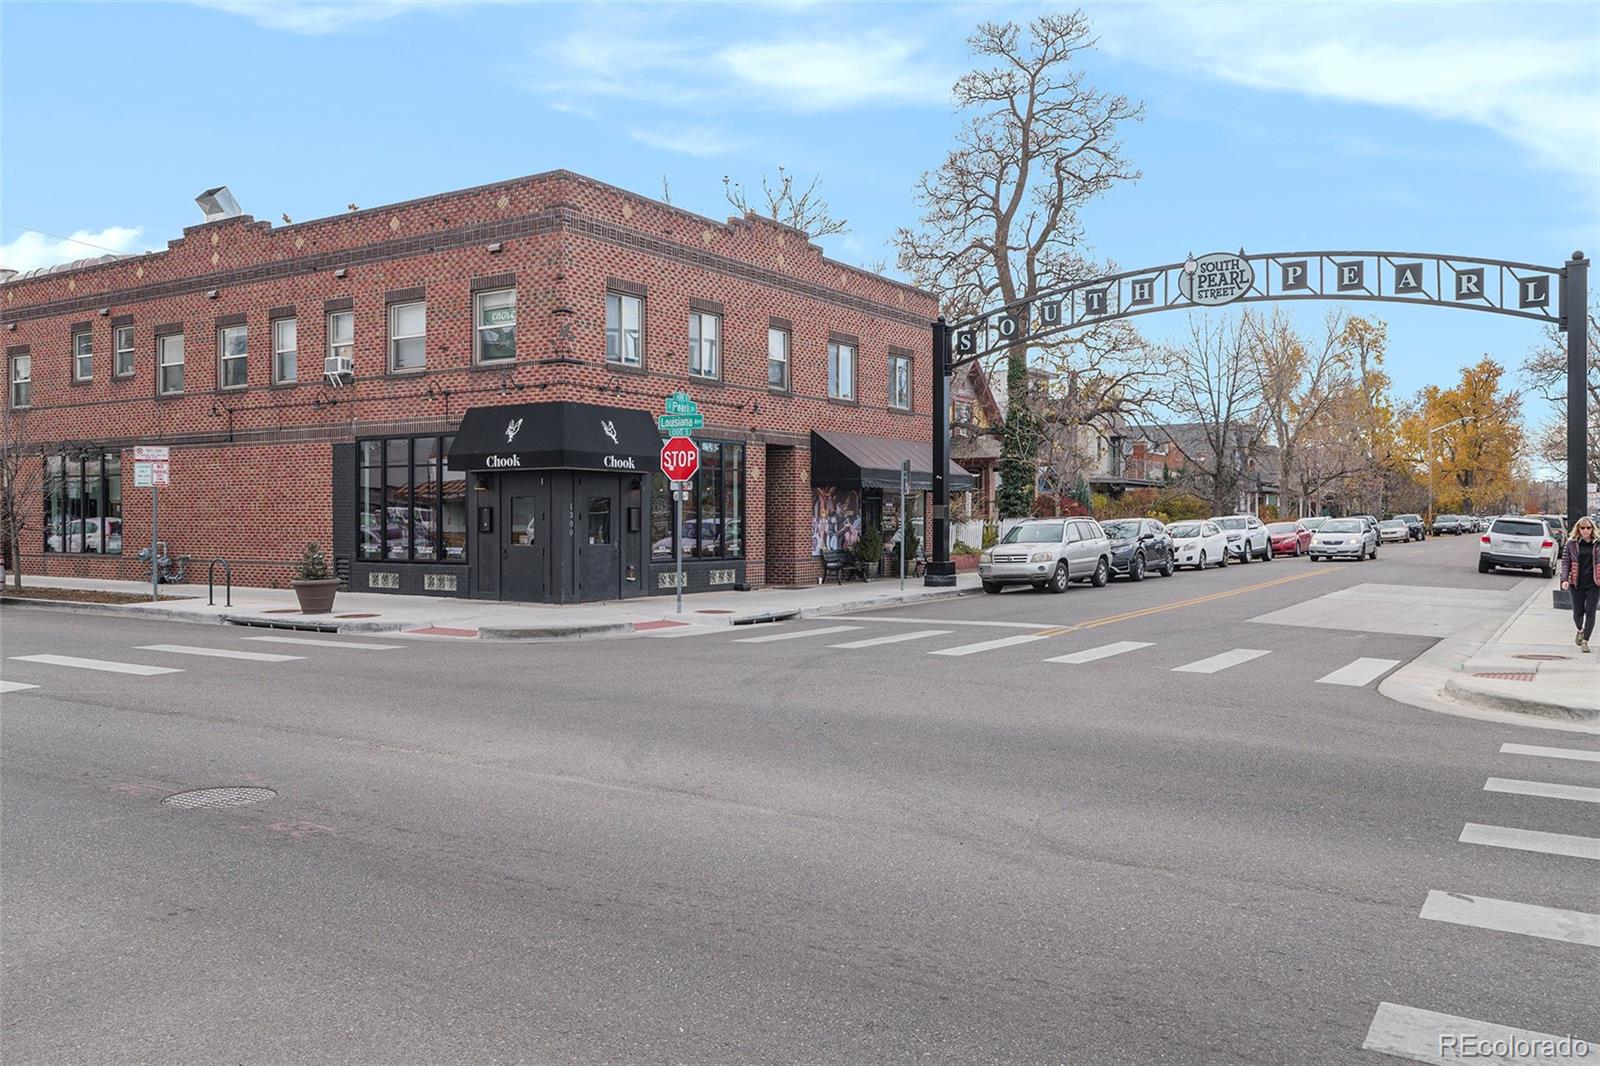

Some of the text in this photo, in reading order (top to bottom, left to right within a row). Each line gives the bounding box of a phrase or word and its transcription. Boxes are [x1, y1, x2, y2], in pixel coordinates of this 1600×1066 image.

[1200, 259, 1240, 273] SOUTH
[1197, 269, 1249, 290] PEARL
[1197, 287, 1236, 299] STREET
[960, 265, 1546, 351] SOUTH PEARL
[672, 401, 690, 412] Pearl
[661, 417, 693, 428] Louisiana
[486, 454, 521, 468] Chook
[603, 455, 636, 469] Chook
[663, 450, 696, 468] STOP
